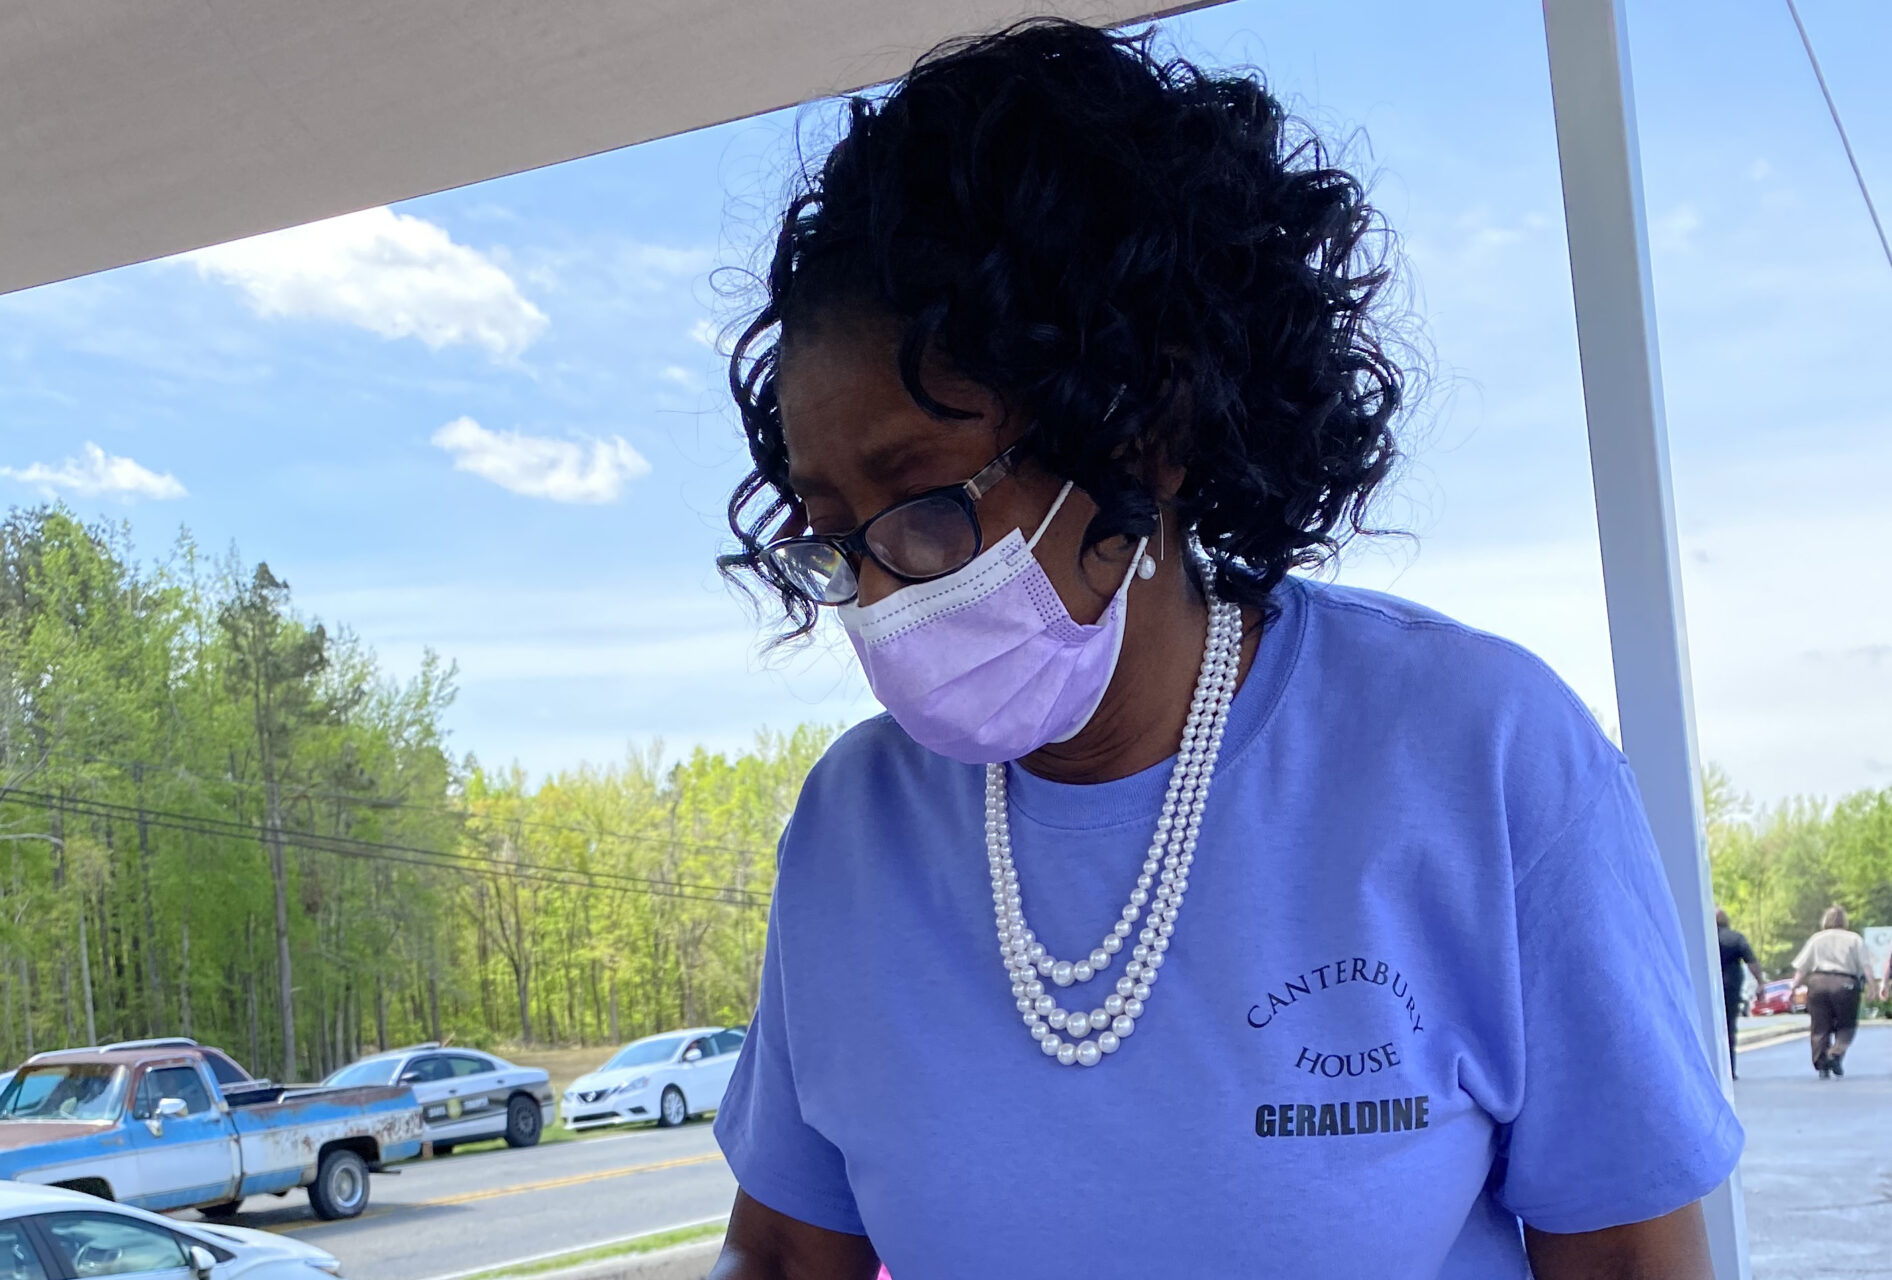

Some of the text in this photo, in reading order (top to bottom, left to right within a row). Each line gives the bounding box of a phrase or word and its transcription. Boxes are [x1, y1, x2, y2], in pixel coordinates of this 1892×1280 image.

[1247, 957, 1425, 1034] CANTERBURY
[1294, 1042, 1401, 1078] HOUSE
[1255, 1095, 1430, 1138] GERALDINE
